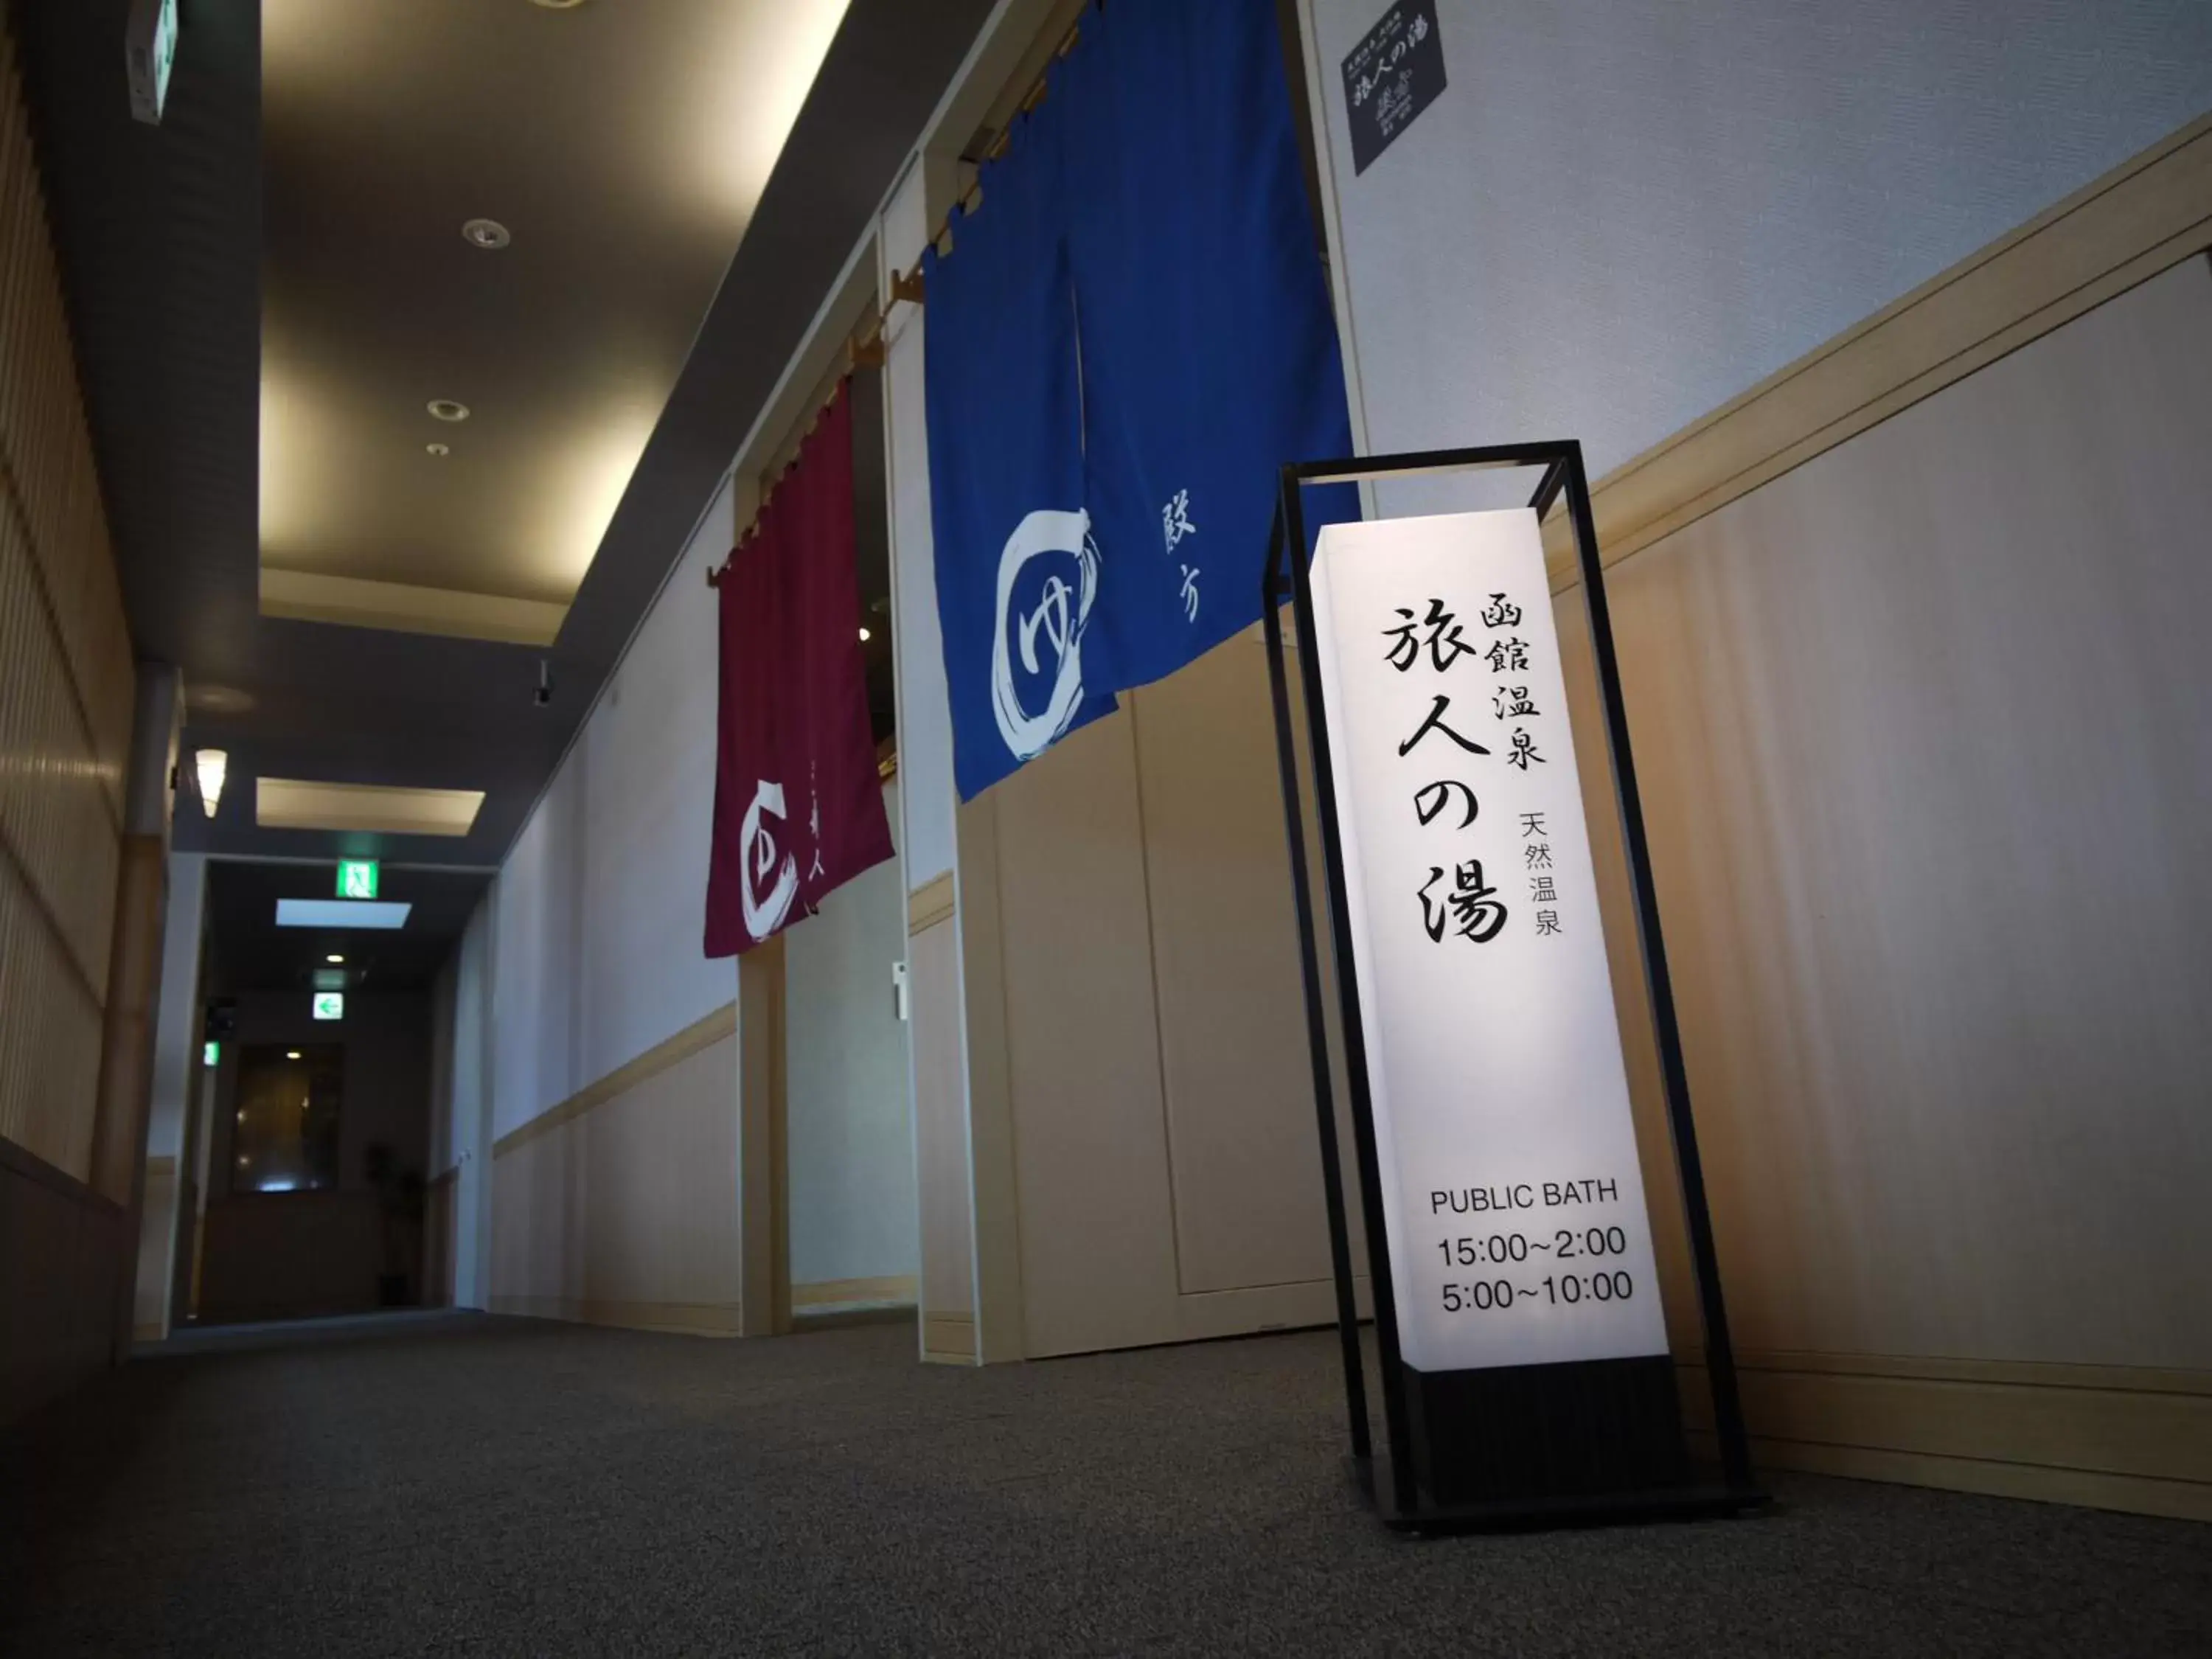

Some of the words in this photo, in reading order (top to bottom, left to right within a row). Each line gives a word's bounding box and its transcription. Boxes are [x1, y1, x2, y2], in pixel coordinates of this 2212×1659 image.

[1481, 593, 1547, 771] 函館温泉
[1381, 599, 1508, 944] 旅人の湯
[1520, 812, 1562, 936] 天然温泉
[1430, 1184, 1534, 1214] PUBLIC
[1543, 1178, 1618, 1206] BATH
